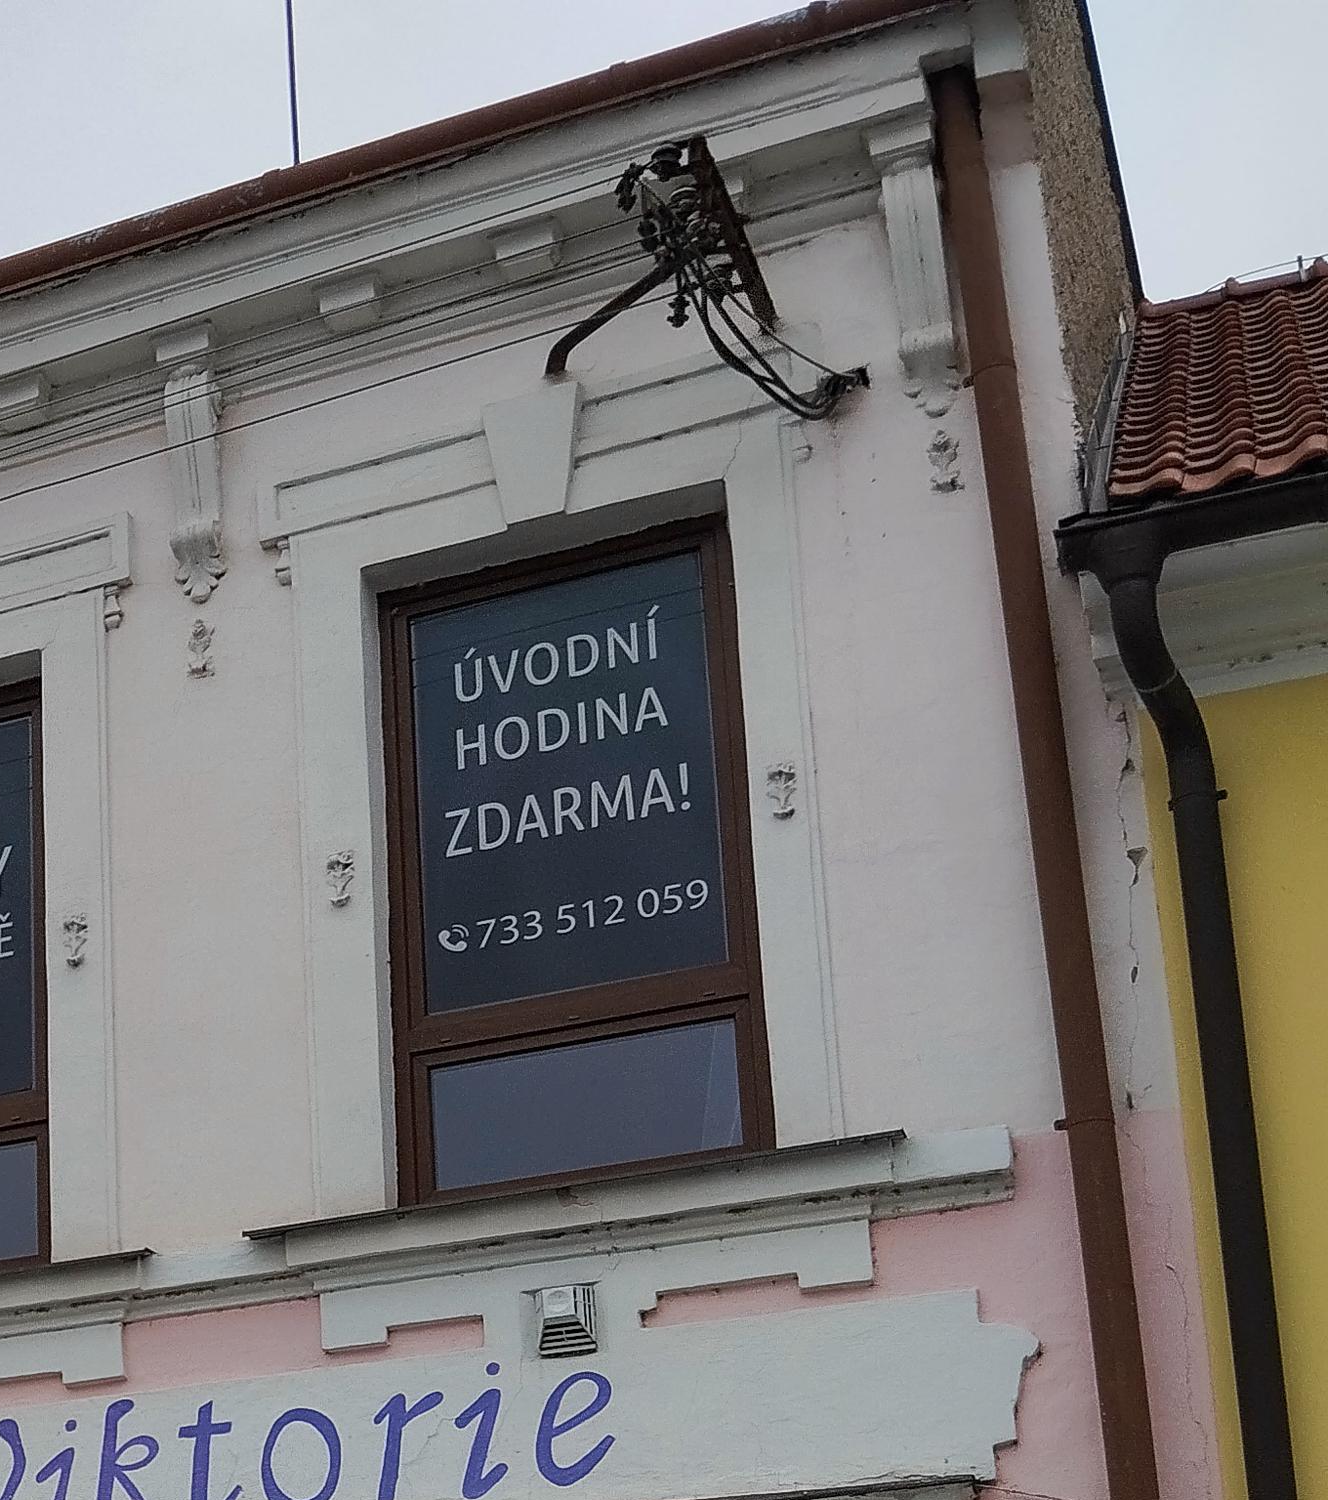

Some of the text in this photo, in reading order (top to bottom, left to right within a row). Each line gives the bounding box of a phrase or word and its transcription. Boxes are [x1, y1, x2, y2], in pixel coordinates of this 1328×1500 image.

[454, 604, 661, 703] ÚVODNÍ
[455, 686, 669, 770] HODINA
[445, 762, 692, 858] ZDARMA!
[476, 879, 708, 949] 733 512 059
